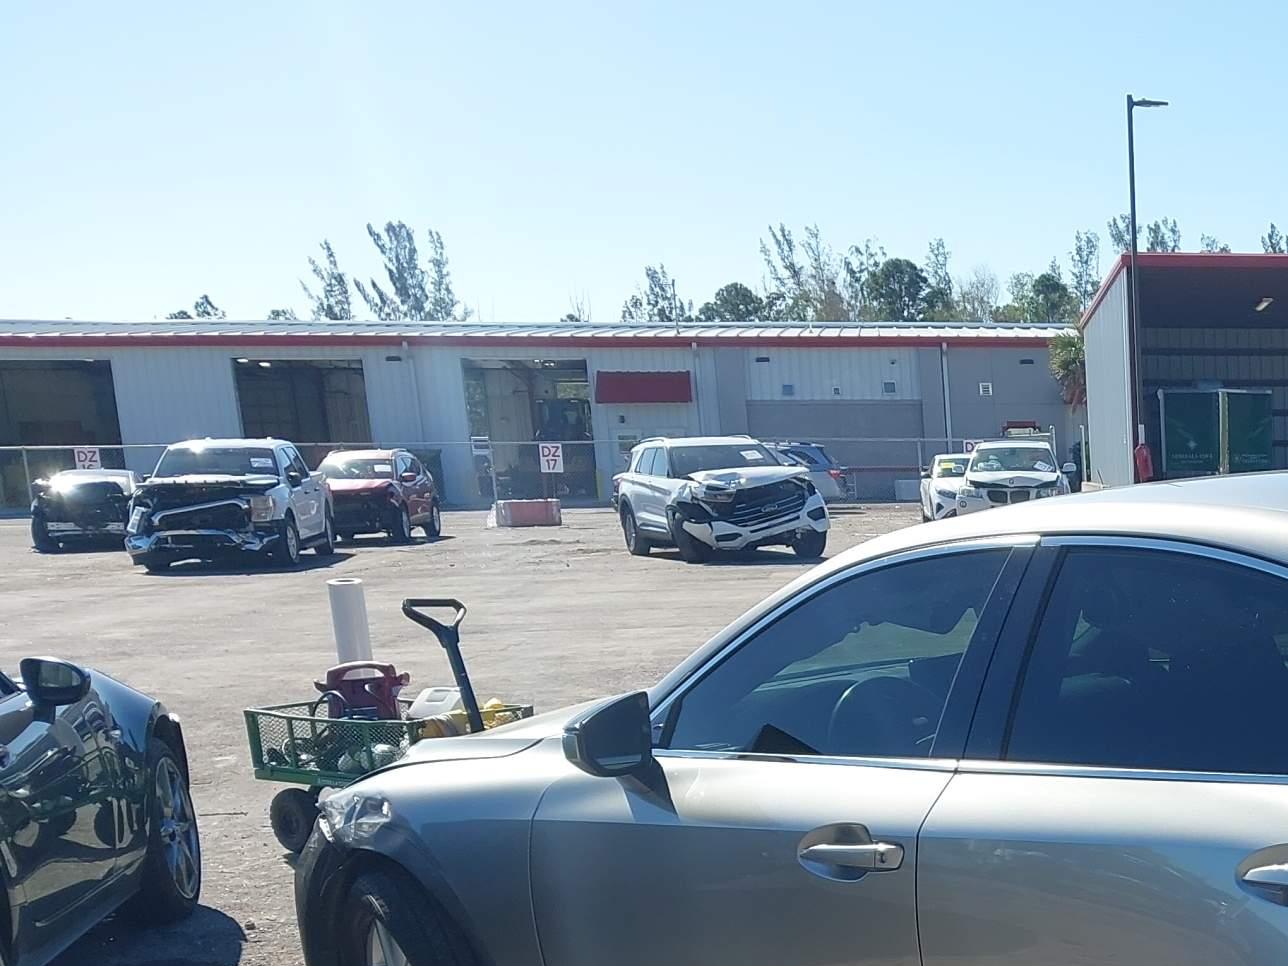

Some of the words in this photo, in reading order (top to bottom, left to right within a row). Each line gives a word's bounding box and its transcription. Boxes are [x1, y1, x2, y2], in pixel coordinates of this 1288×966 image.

[76, 450, 97, 463] DZ
[541, 445, 561, 458] DZ
[545, 458, 557, 471] 17
